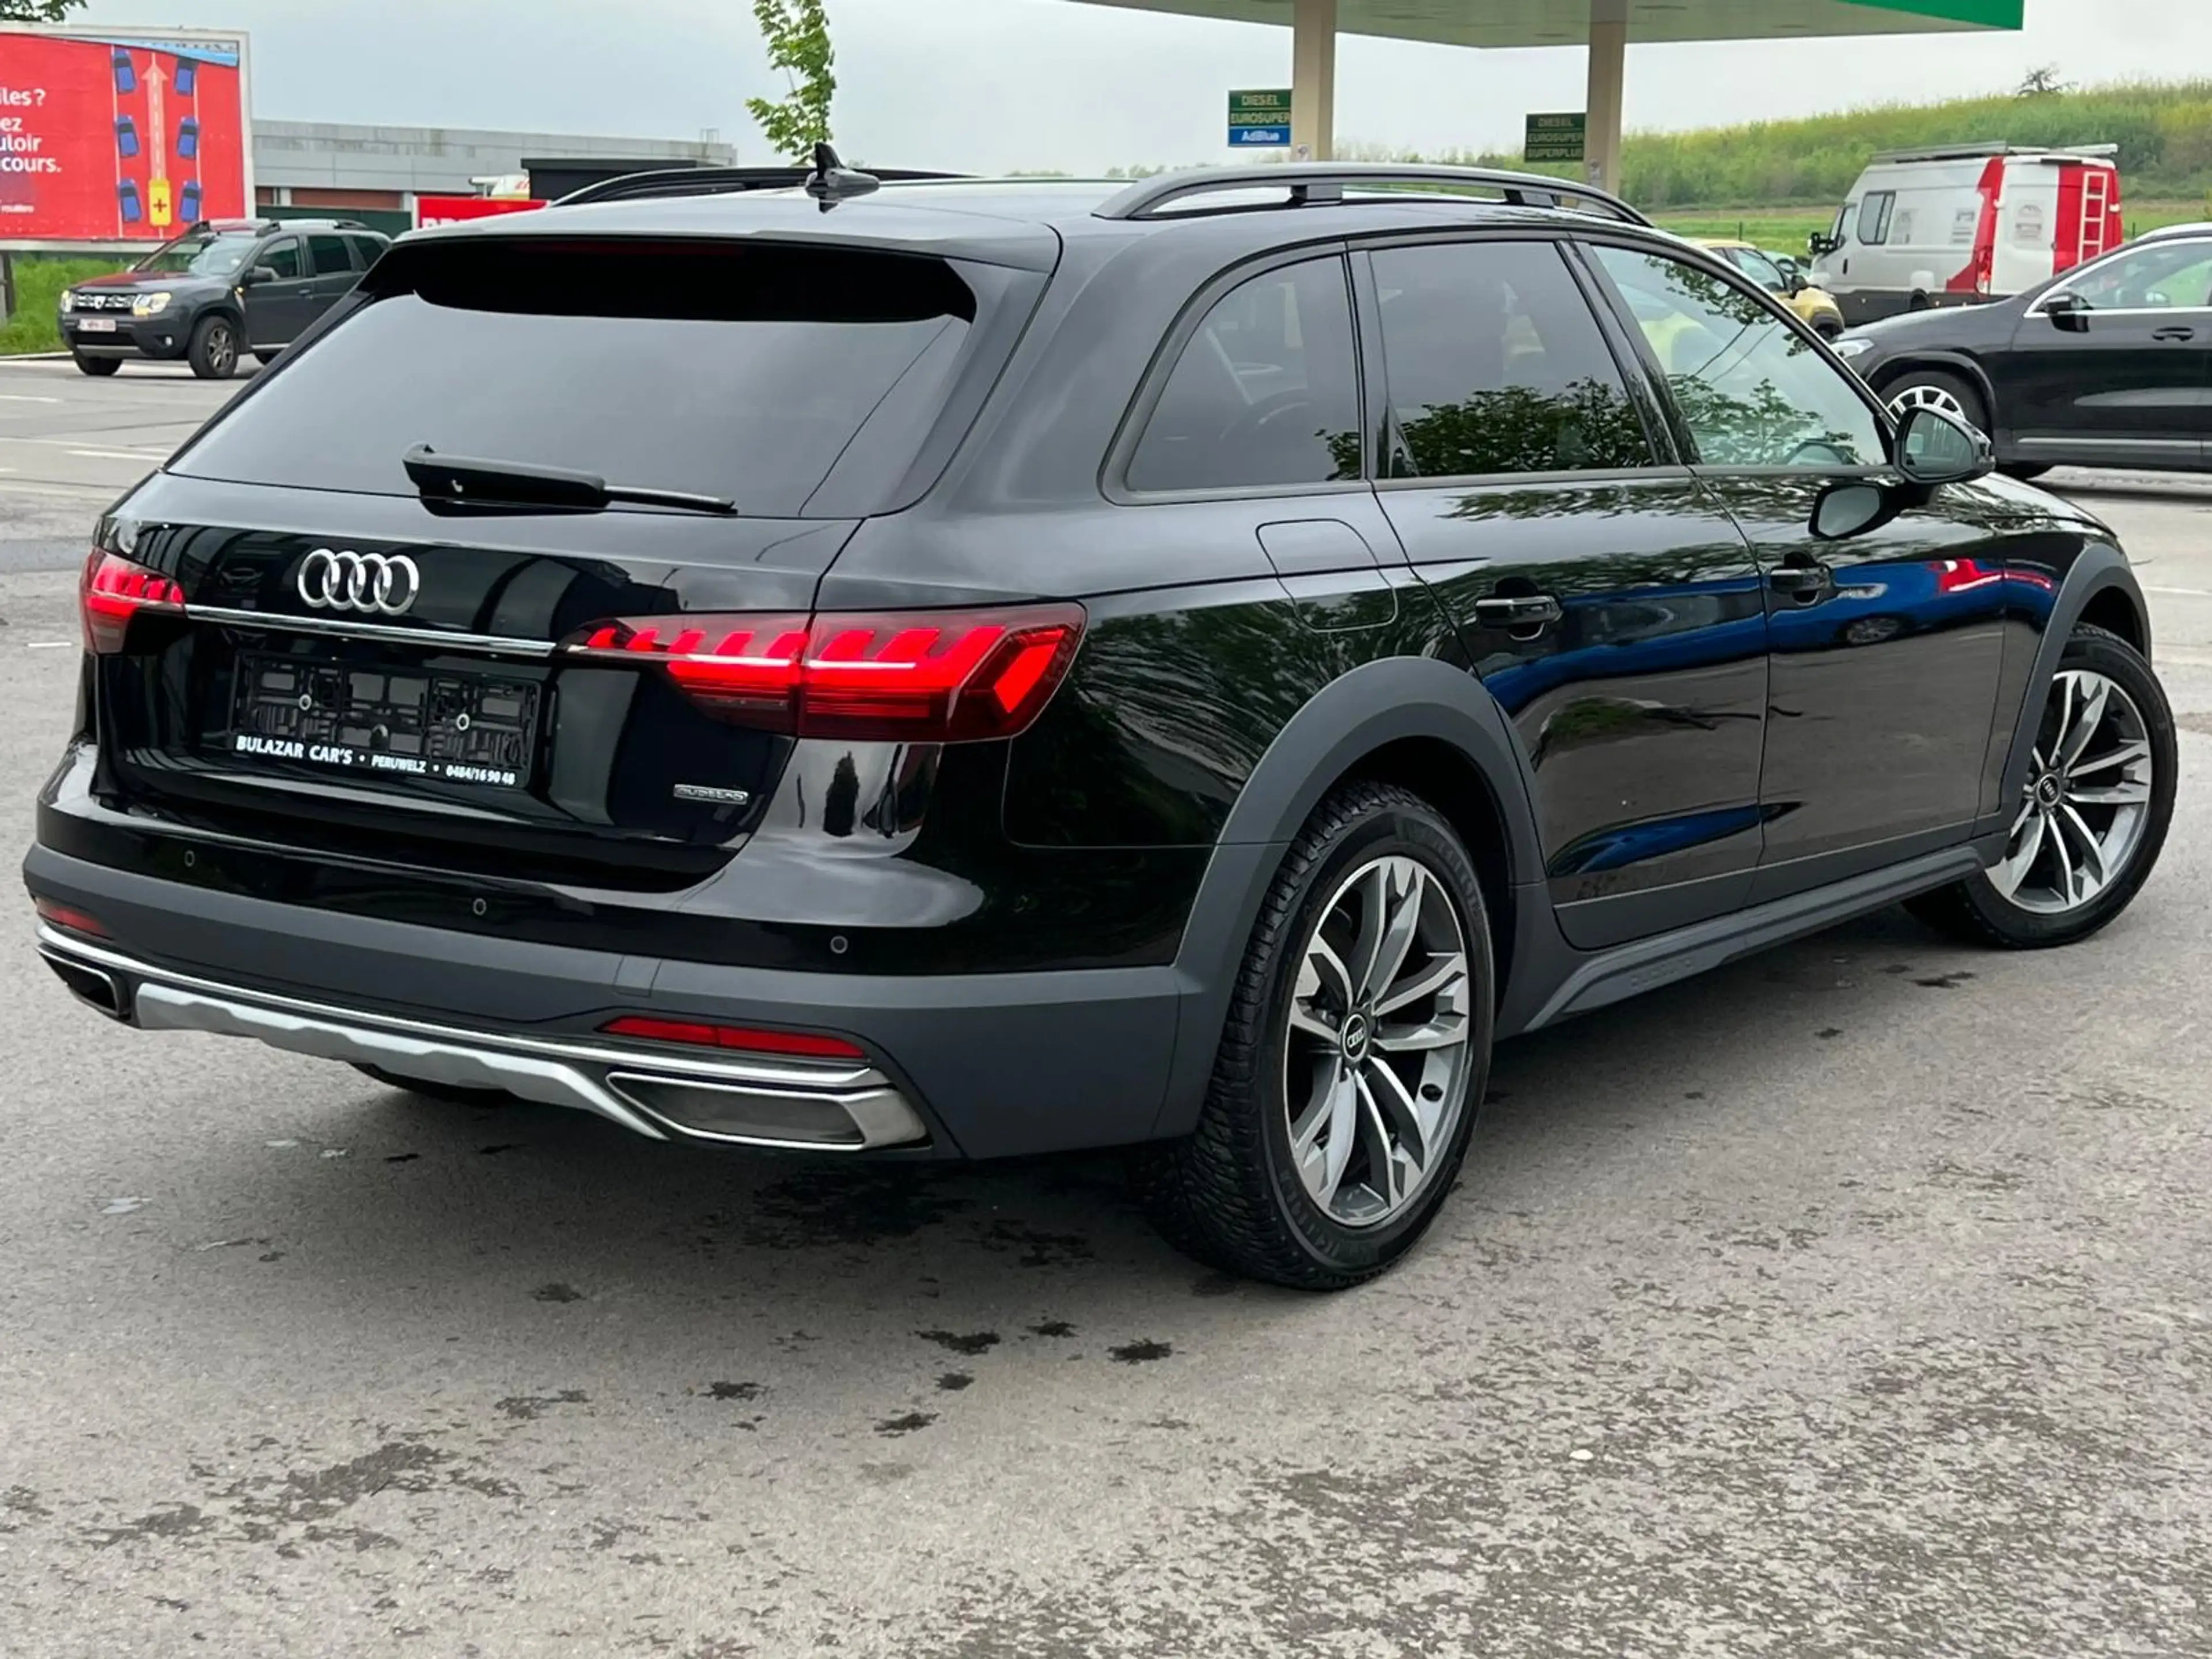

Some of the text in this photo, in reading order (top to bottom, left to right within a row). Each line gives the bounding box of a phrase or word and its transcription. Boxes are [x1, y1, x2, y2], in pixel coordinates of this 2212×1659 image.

[1241, 94, 1280, 106] DIESEL
[1230, 112, 1291, 123] EUROSUPER
[1538, 118, 1574, 127] DIESEL
[1241, 130, 1279, 141] AdBlue
[236, 735, 304, 758] BULAZAR
[309, 745, 353, 764] CAR'S
